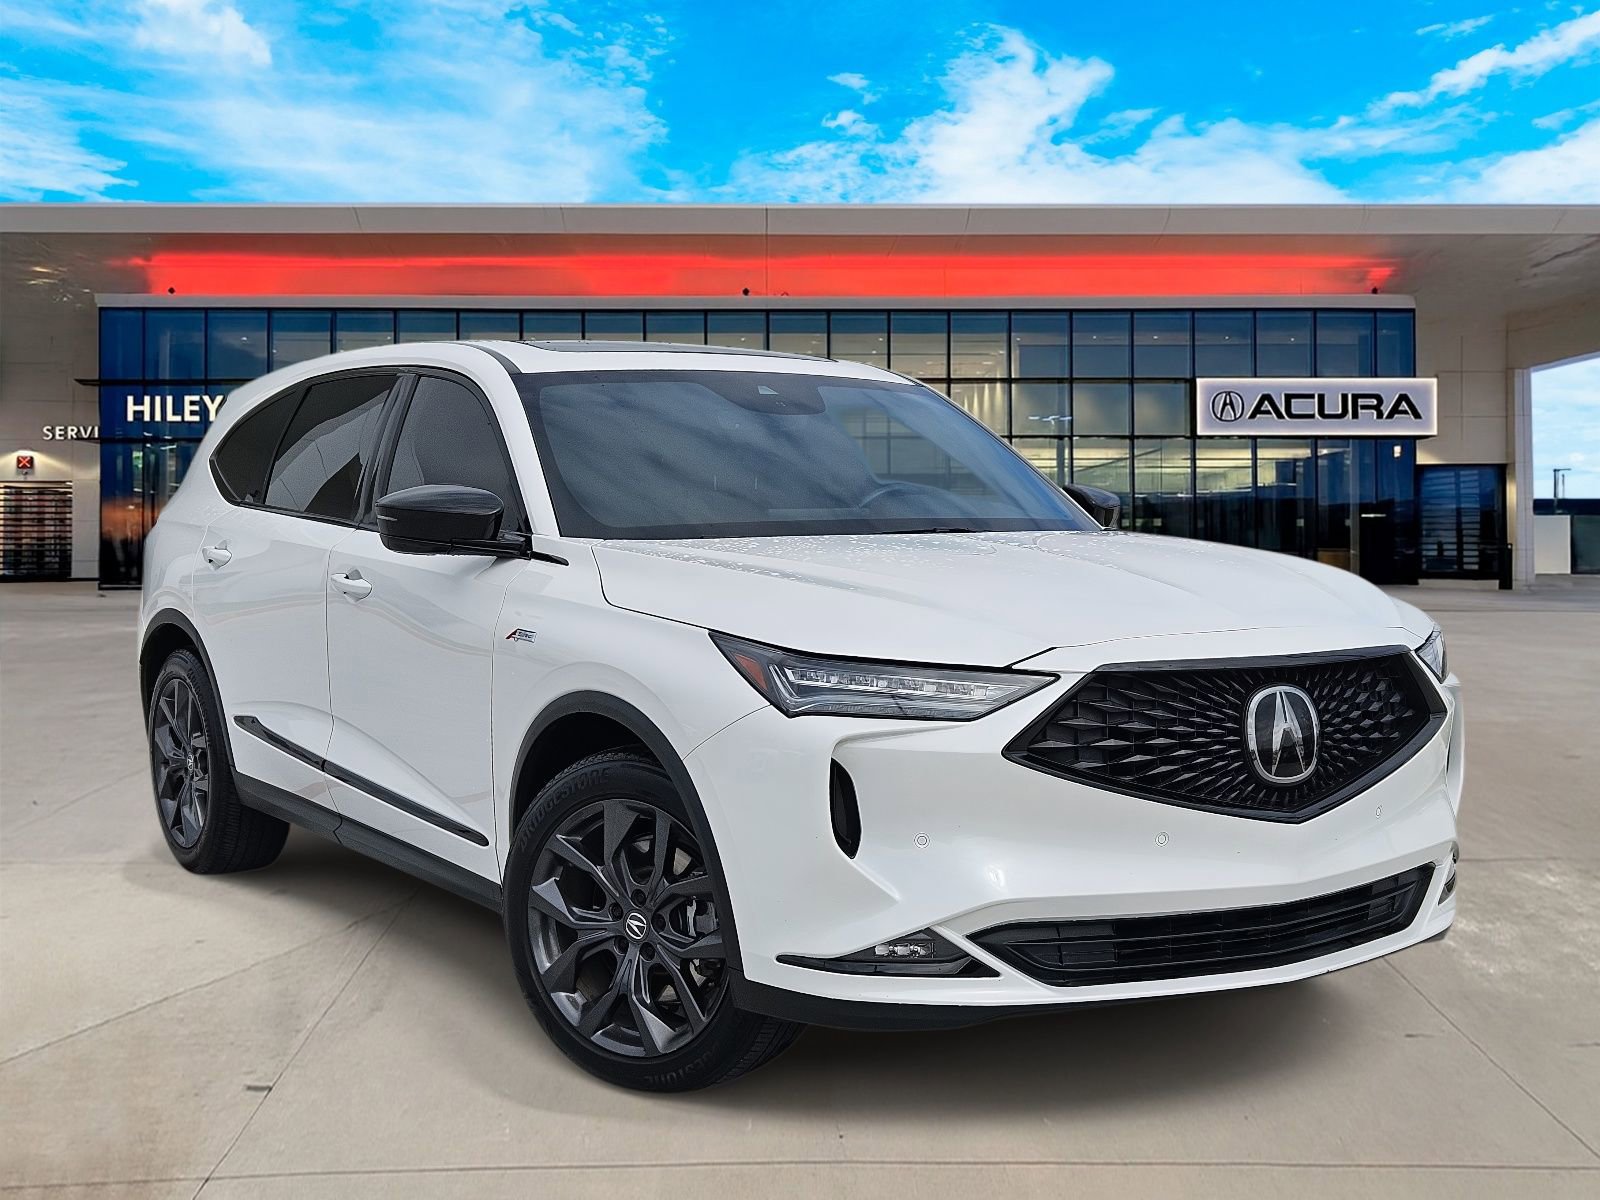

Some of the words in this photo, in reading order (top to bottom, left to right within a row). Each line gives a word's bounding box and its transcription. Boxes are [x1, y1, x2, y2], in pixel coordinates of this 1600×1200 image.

[126, 394, 224, 422] HILEY
[1247, 392, 1423, 420] ACURA
[42, 425, 99, 440] SERVI
[519, 767, 609, 852] BRIDGESTONE
